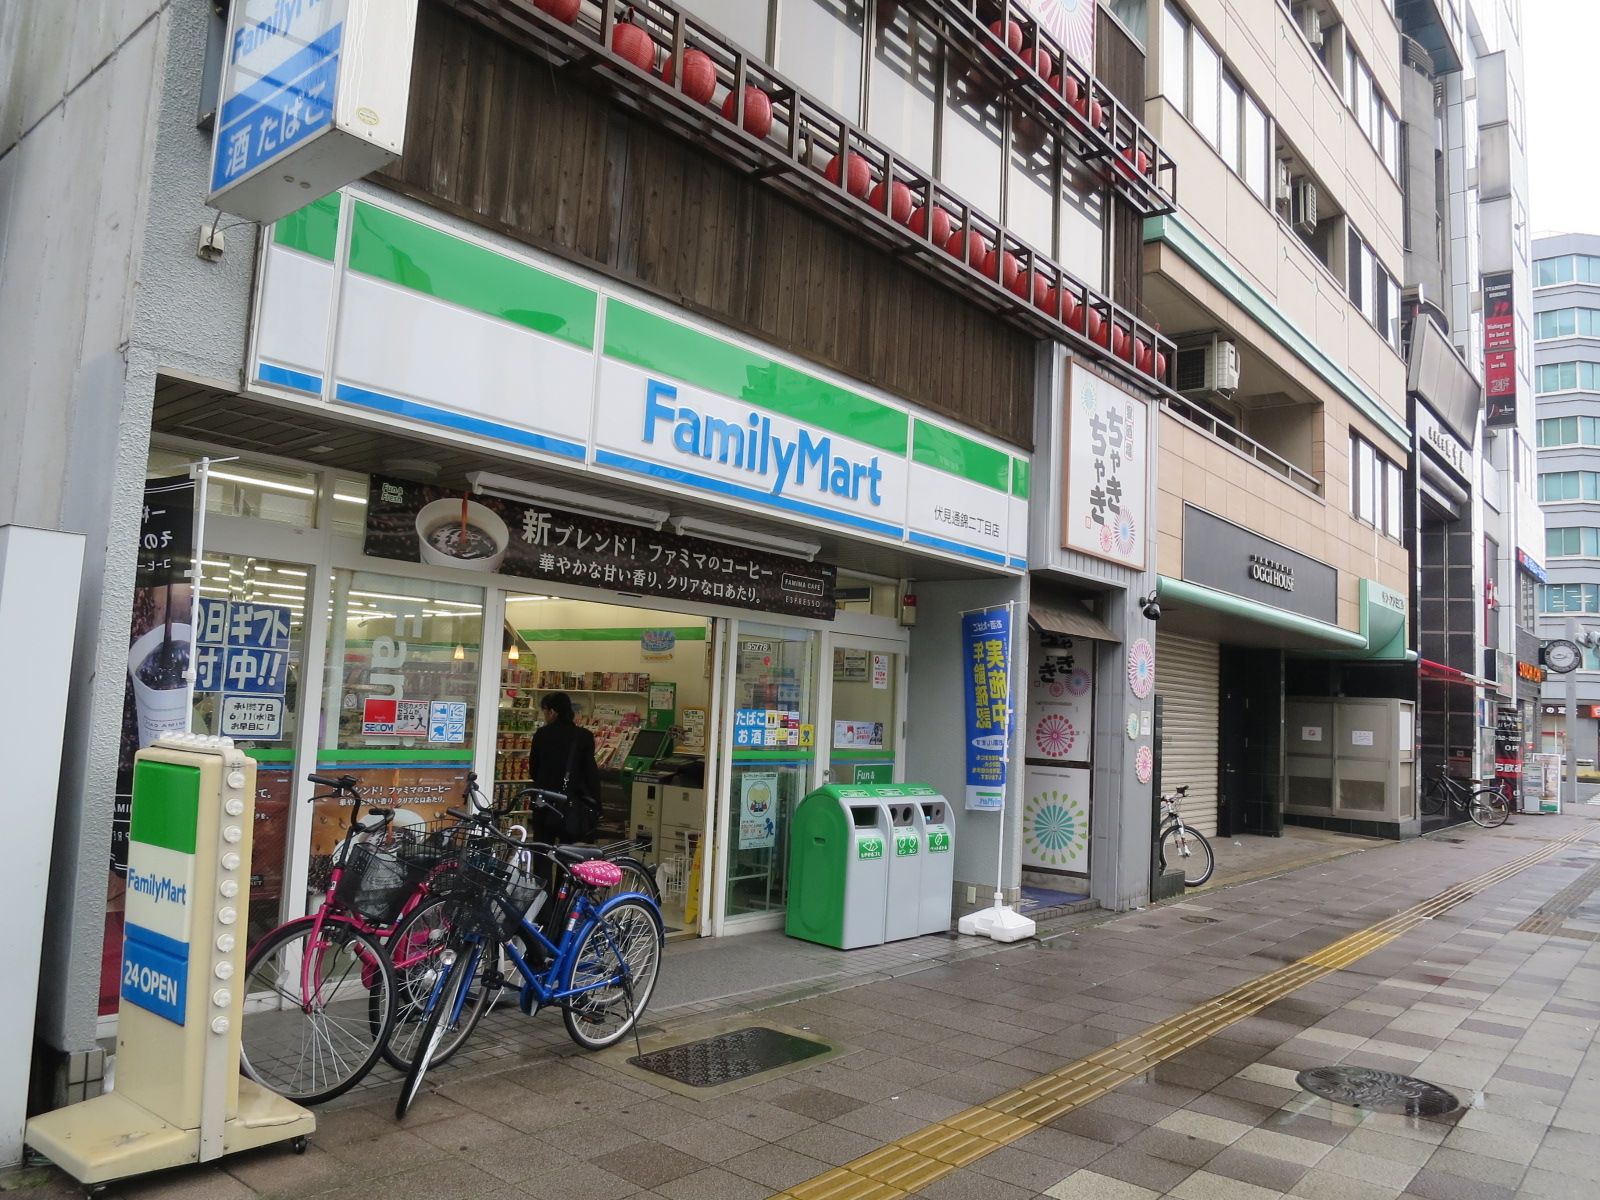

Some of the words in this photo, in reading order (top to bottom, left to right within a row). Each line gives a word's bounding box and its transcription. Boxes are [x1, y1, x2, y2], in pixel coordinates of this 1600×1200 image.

[225, 126, 252, 178] 酒
[257, 81, 326, 157] たばこ
[641, 377, 882, 506] FamilyMart
[1089, 413, 1107, 526] ちゃき
[1106, 406, 1124, 516] ちゃき
[647, 543, 774, 581] ファミマのコーヒー
[538, 552, 762, 604] 華やかな甘い香り、クリアな口あたり。
[785, 579, 806, 588] FAMIMA
[1253, 564, 1273, 583] OGGI
[1273, 571, 1294, 592] HOUSE
[785, 596, 820, 607] ESPRESSO
[748, 643, 769, 652] 55778
[364, 723, 394, 732] SECOM
[736, 712, 765, 726] たばこ
[738, 729, 762, 744] お酒
[857, 770, 870, 780] Fun
[127, 867, 187, 906] FamilyMart
